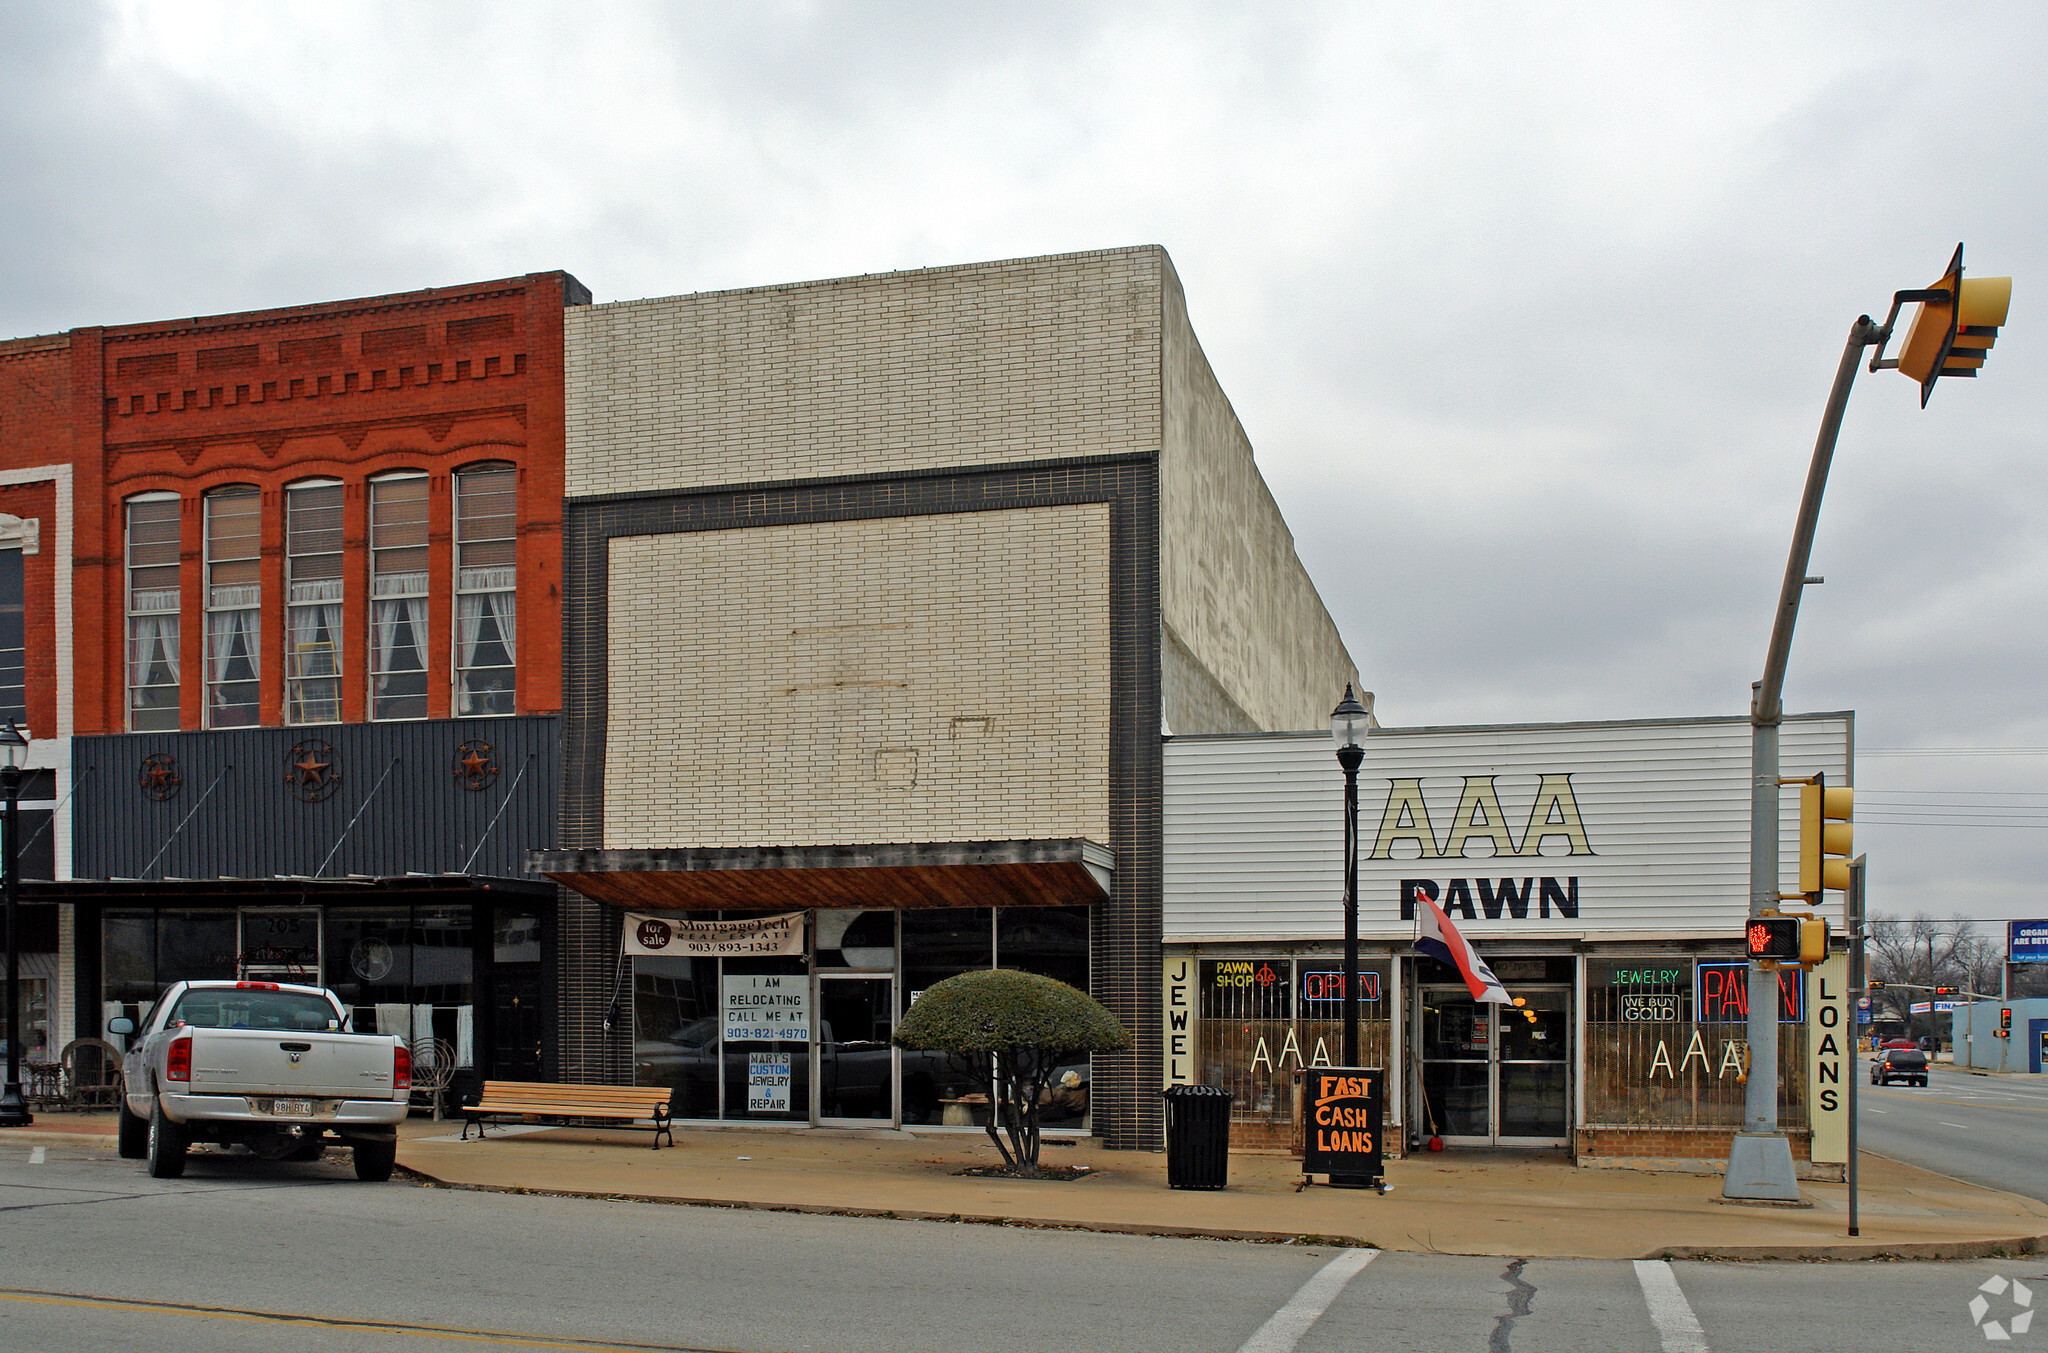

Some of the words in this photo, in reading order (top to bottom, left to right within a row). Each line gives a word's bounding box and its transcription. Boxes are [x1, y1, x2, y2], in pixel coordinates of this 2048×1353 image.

[1363, 773, 1600, 860] AAA
[1400, 876, 1579, 921] PAWN
[267, 919, 299, 933] 205
[645, 921, 662, 933] for
[679, 917, 790, 934] MortgageTech
[643, 934, 666, 946] sale
[729, 931, 791, 940] ESTATE
[2013, 937, 2031, 945] ARE
[688, 942, 778, 953] 903/893-1343
[1216, 961, 1254, 974] PAWN
[752, 978, 756, 988] I
[765, 977, 780, 988] AM
[1216, 975, 1253, 987] SHOP
[1612, 969, 1679, 984] JEWELRY
[730, 995, 801, 1006] RELOCATING
[1625, 997, 1645, 1007] WE
[1648, 997, 1676, 1007] BUY
[728, 1012, 757, 1022] CALL
[766, 1011, 781, 1021] ME
[789, 1011, 803, 1022] AT
[1625, 1007, 1676, 1021] GOLD
[1169, 961, 1188, 1087] JEWEL
[727, 1028, 808, 1039] 903-821-4970
[1817, 977, 1840, 1113] LOANS
[750, 1053, 789, 1063] MARY'S
[750, 1064, 790, 1075] CUSTOM
[749, 1076, 789, 1086] JEWELRY
[1320, 1076, 1372, 1098] FAST
[765, 1088, 772, 1098] &
[750, 1098, 786, 1109] REPAIR
[1315, 1105, 1367, 1128] CASH
[1317, 1129, 1373, 1153] LOANS
